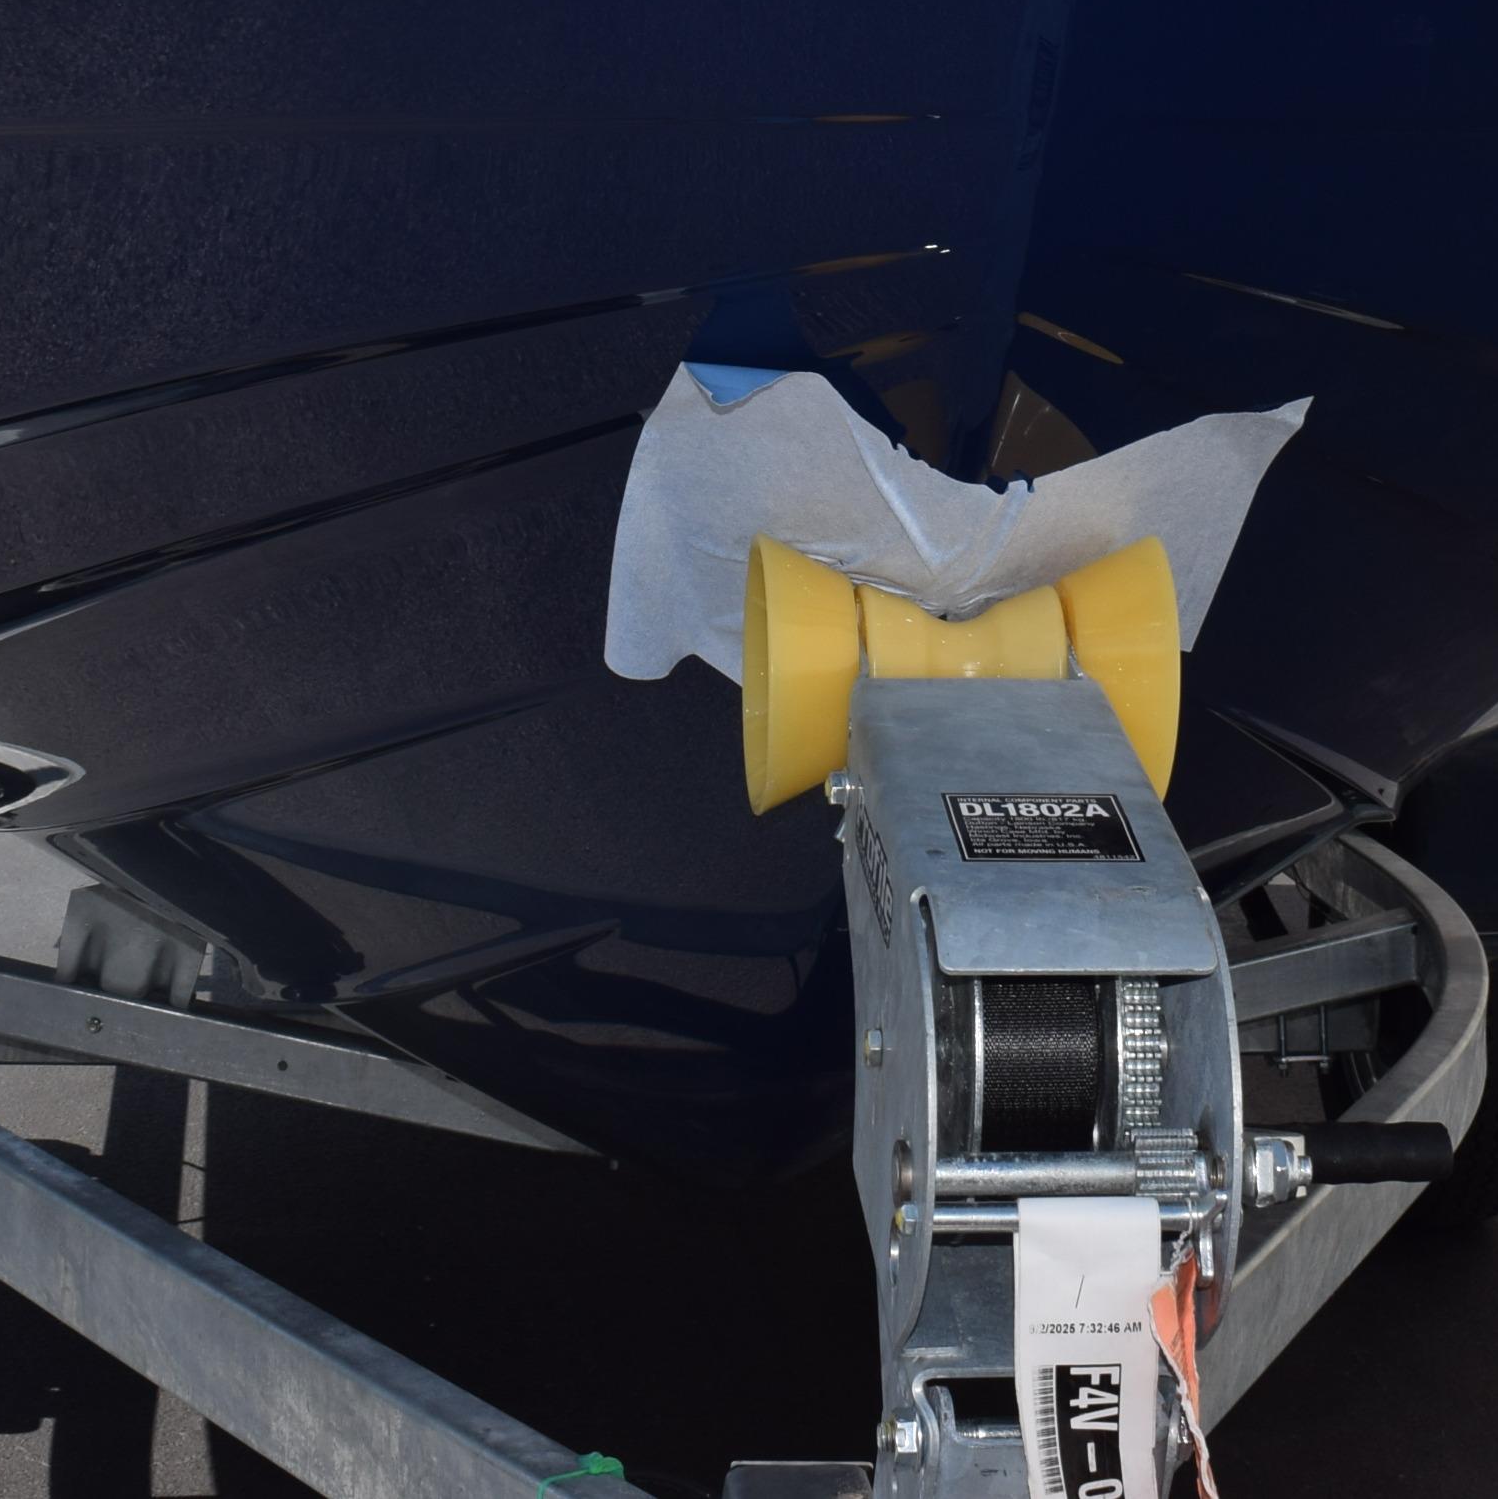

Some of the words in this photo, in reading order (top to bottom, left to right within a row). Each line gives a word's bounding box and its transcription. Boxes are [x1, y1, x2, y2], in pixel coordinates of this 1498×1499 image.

[958, 802, 1111, 817] DL1802A
[1079, 1322, 1121, 1334] 7:32:46
[1123, 1321, 1142, 1333] AM
